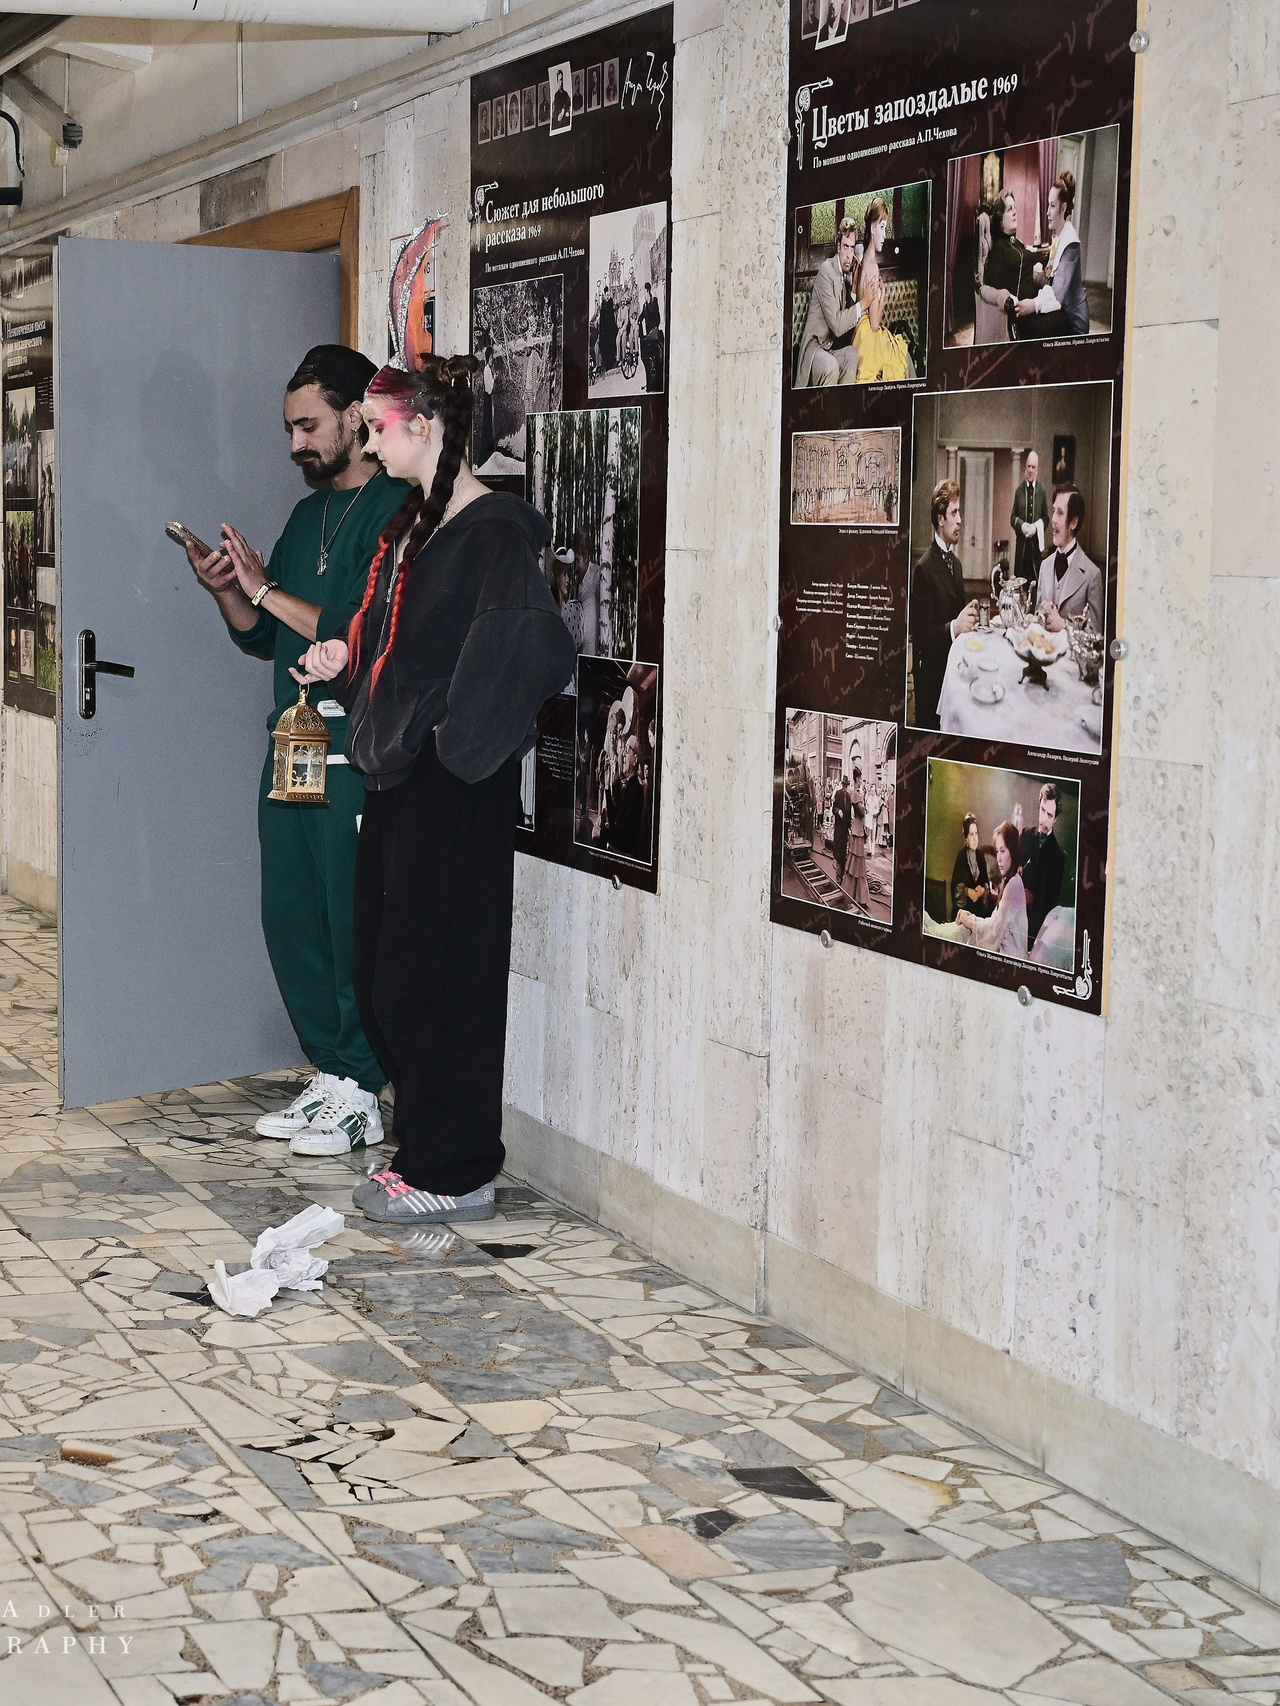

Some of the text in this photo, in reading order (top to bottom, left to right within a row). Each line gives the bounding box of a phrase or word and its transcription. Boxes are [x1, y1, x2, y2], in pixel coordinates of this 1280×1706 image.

[812, 73, 1019, 150] Цветы запоздалые 1969
[812, 156, 822, 169] По
[888, 136, 916, 154] рассказа
[916, 126, 958, 145] А.П.Чехова
[485, 183, 605, 224] Сюжет для небольшого
[485, 224, 542, 253] рассказа 1969
